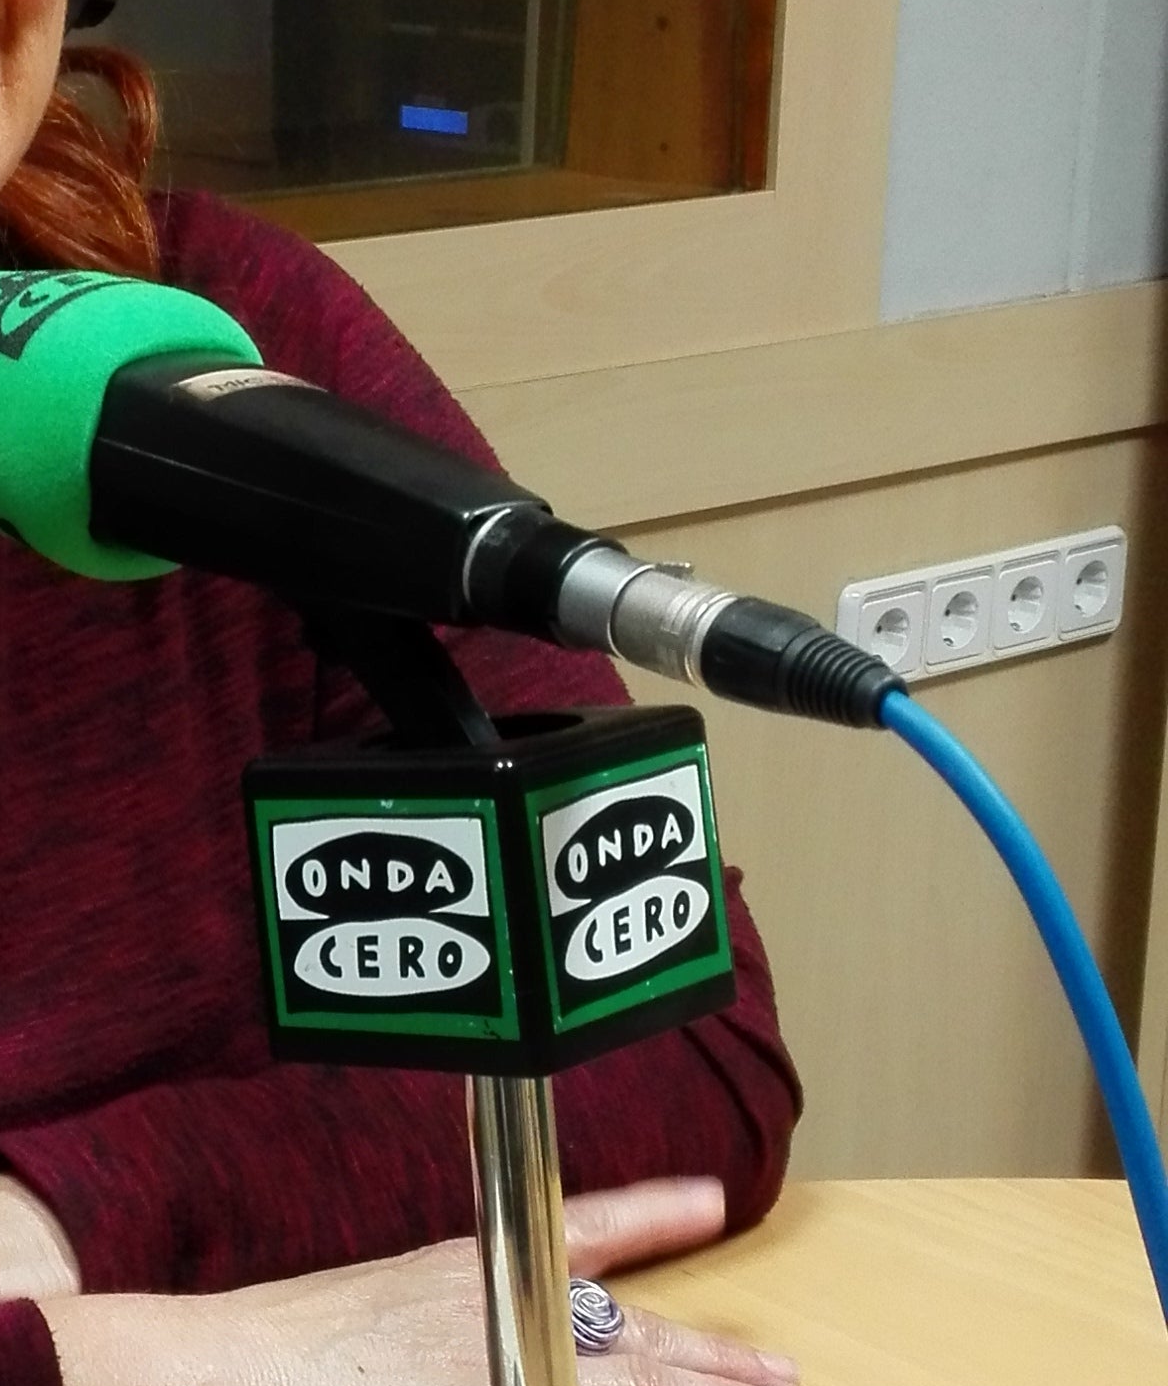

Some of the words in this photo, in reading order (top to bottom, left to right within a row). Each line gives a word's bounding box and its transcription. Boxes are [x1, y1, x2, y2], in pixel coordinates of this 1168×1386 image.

[567, 813, 683, 883] ONDA
[302, 858, 456, 898] ONDA
[584, 890, 691, 963] CERO
[319, 934, 463, 979] CERO
